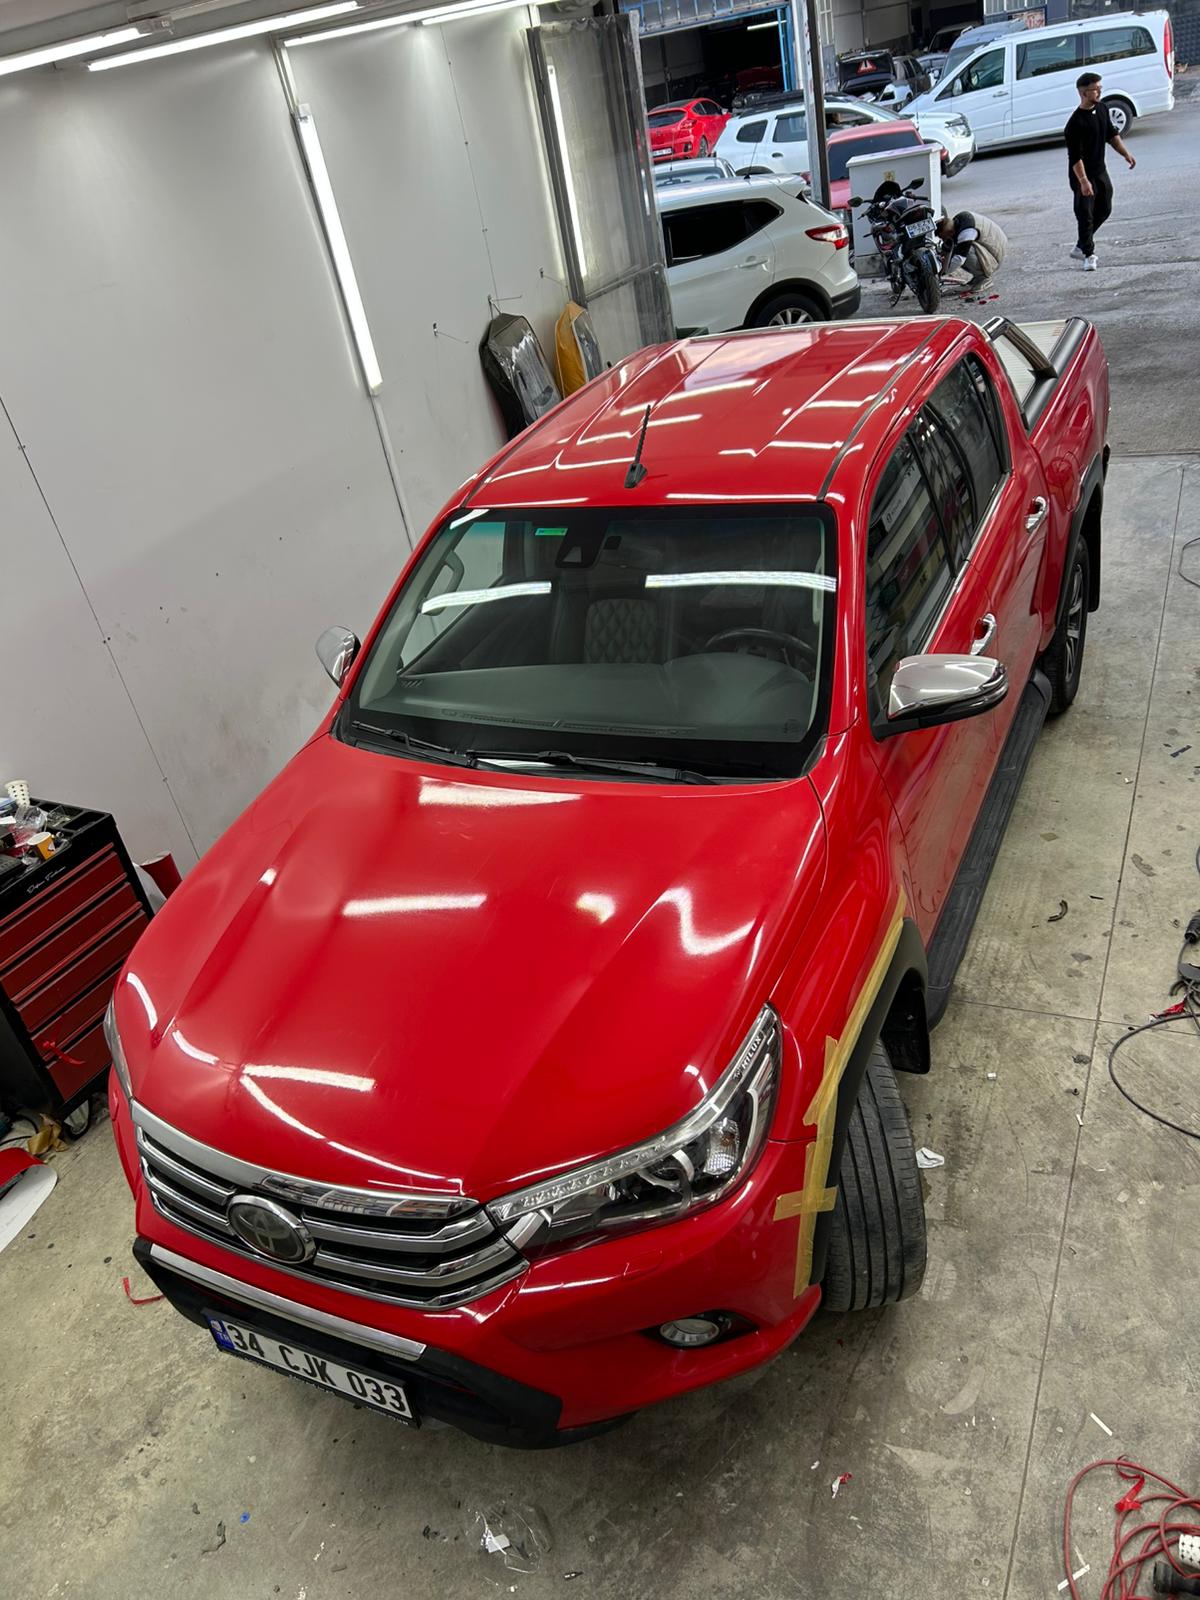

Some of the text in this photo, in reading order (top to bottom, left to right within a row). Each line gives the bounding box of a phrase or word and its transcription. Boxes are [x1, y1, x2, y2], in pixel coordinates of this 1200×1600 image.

[742, 1036, 761, 1069] HILUX
[227, 1325, 265, 1358] 34
[278, 1344, 337, 1387] CJK
[346, 1371, 406, 1412] 033
